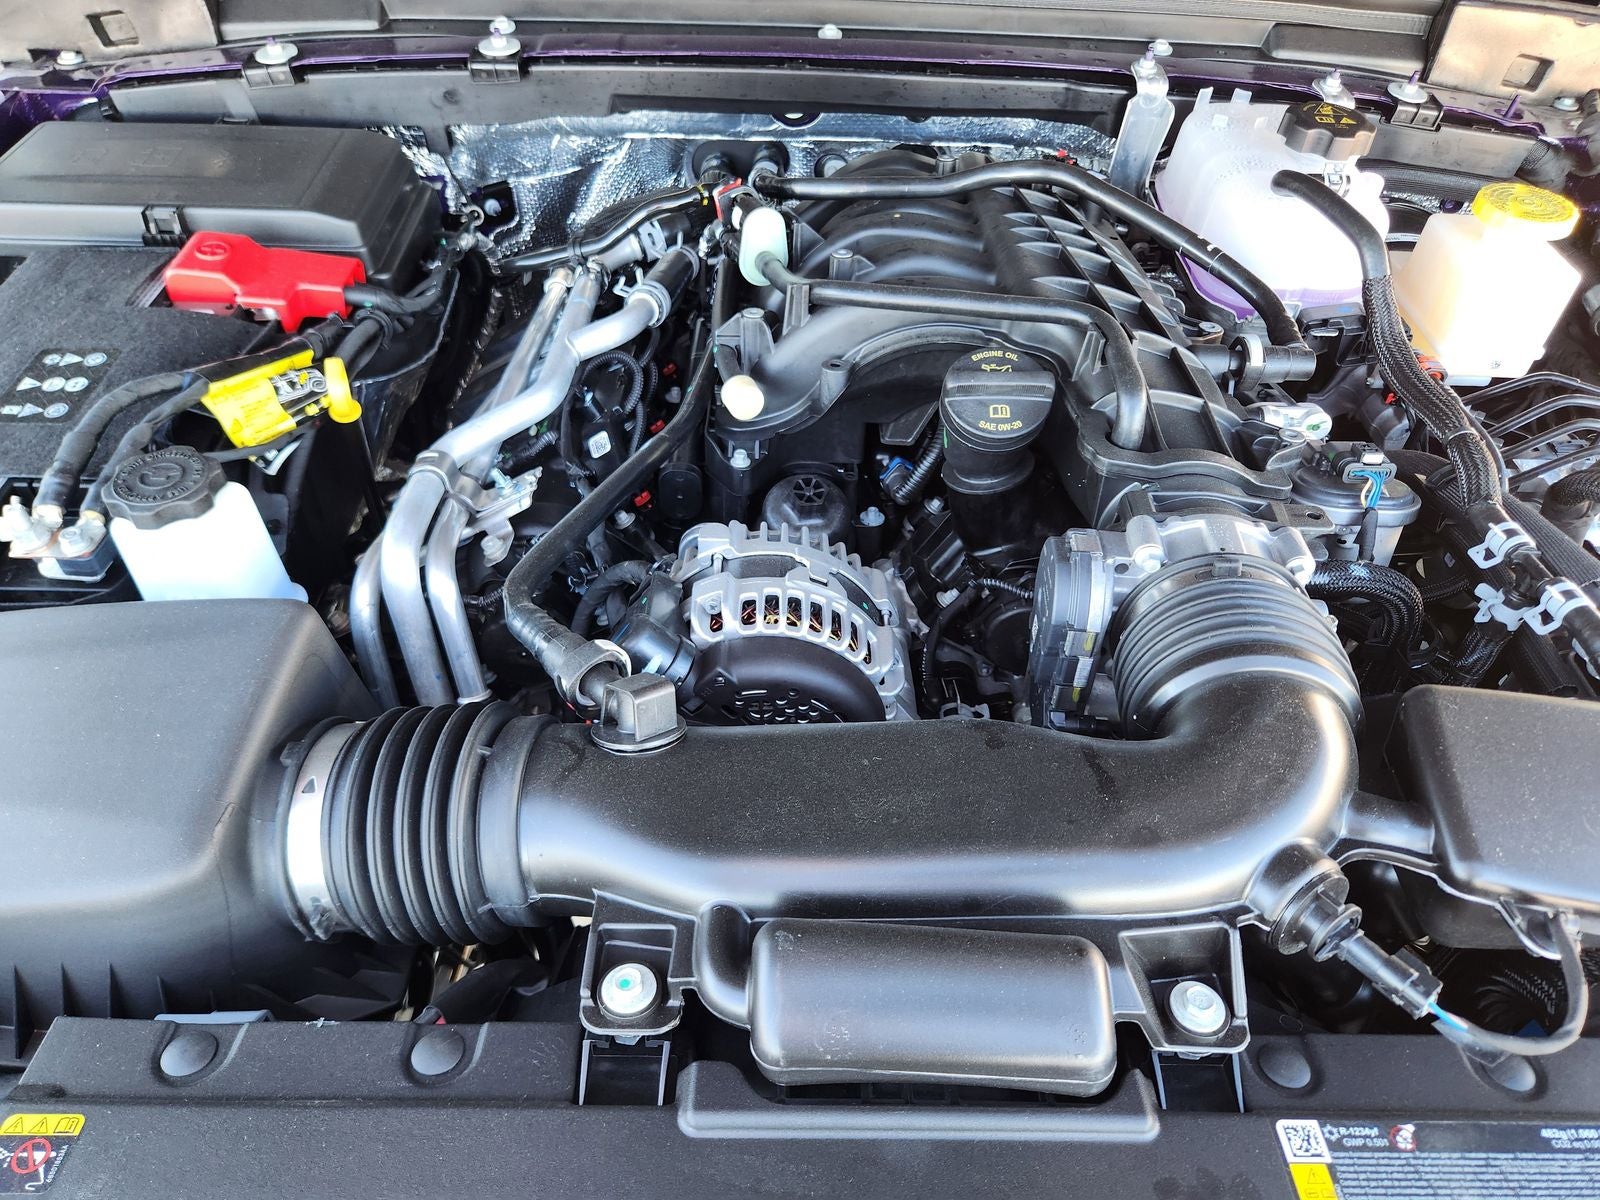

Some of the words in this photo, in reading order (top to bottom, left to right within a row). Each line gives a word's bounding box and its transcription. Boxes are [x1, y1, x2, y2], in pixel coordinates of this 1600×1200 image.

[971, 350, 1003, 362] ENGINE
[1005, 351, 1019, 362] OIL
[978, 420, 997, 431] SAE
[998, 420, 1023, 431] 0W-20
[1342, 1137, 1364, 1148] GWP
